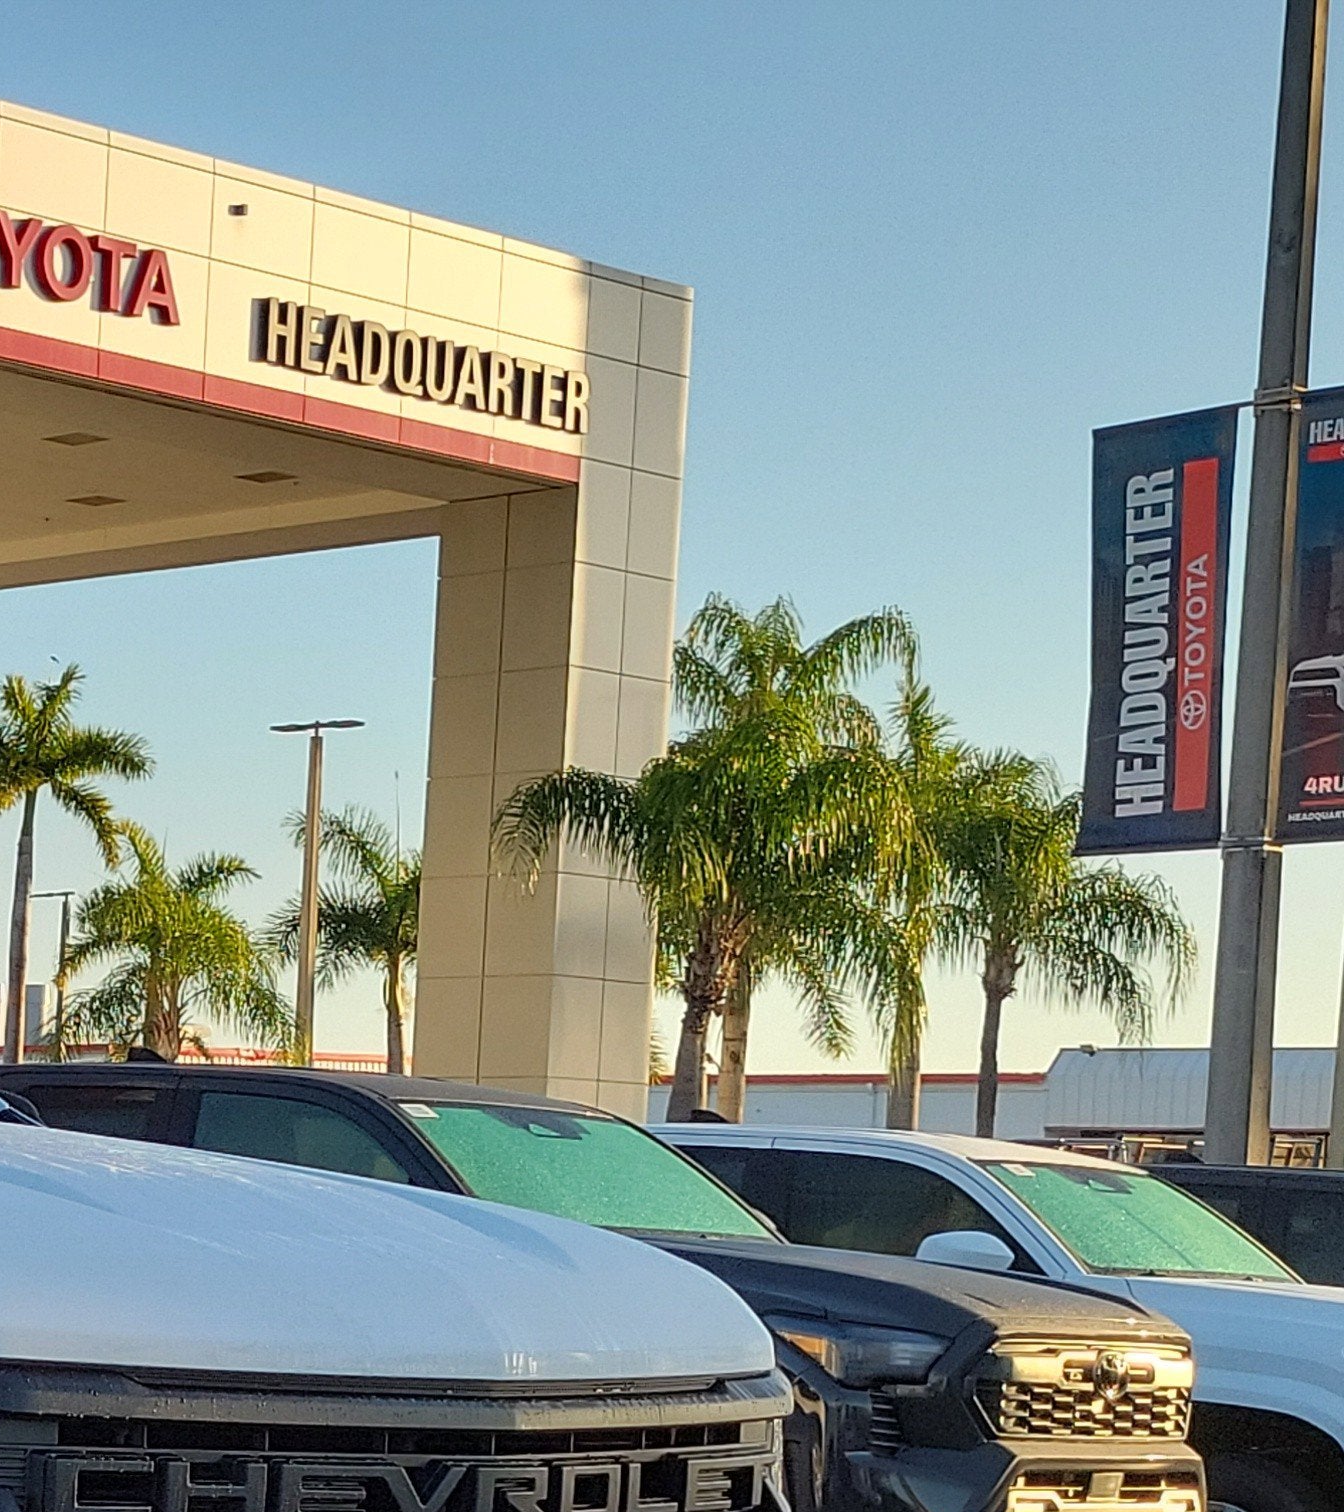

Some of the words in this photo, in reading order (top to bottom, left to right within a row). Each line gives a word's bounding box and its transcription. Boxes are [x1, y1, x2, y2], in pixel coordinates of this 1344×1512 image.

[258, 296, 590, 434] HEADQUARTER
[1309, 418, 1344, 444] HEA
[1115, 466, 1175, 819] HEADQUARTER
[1183, 554, 1209, 687] TOYOTA
